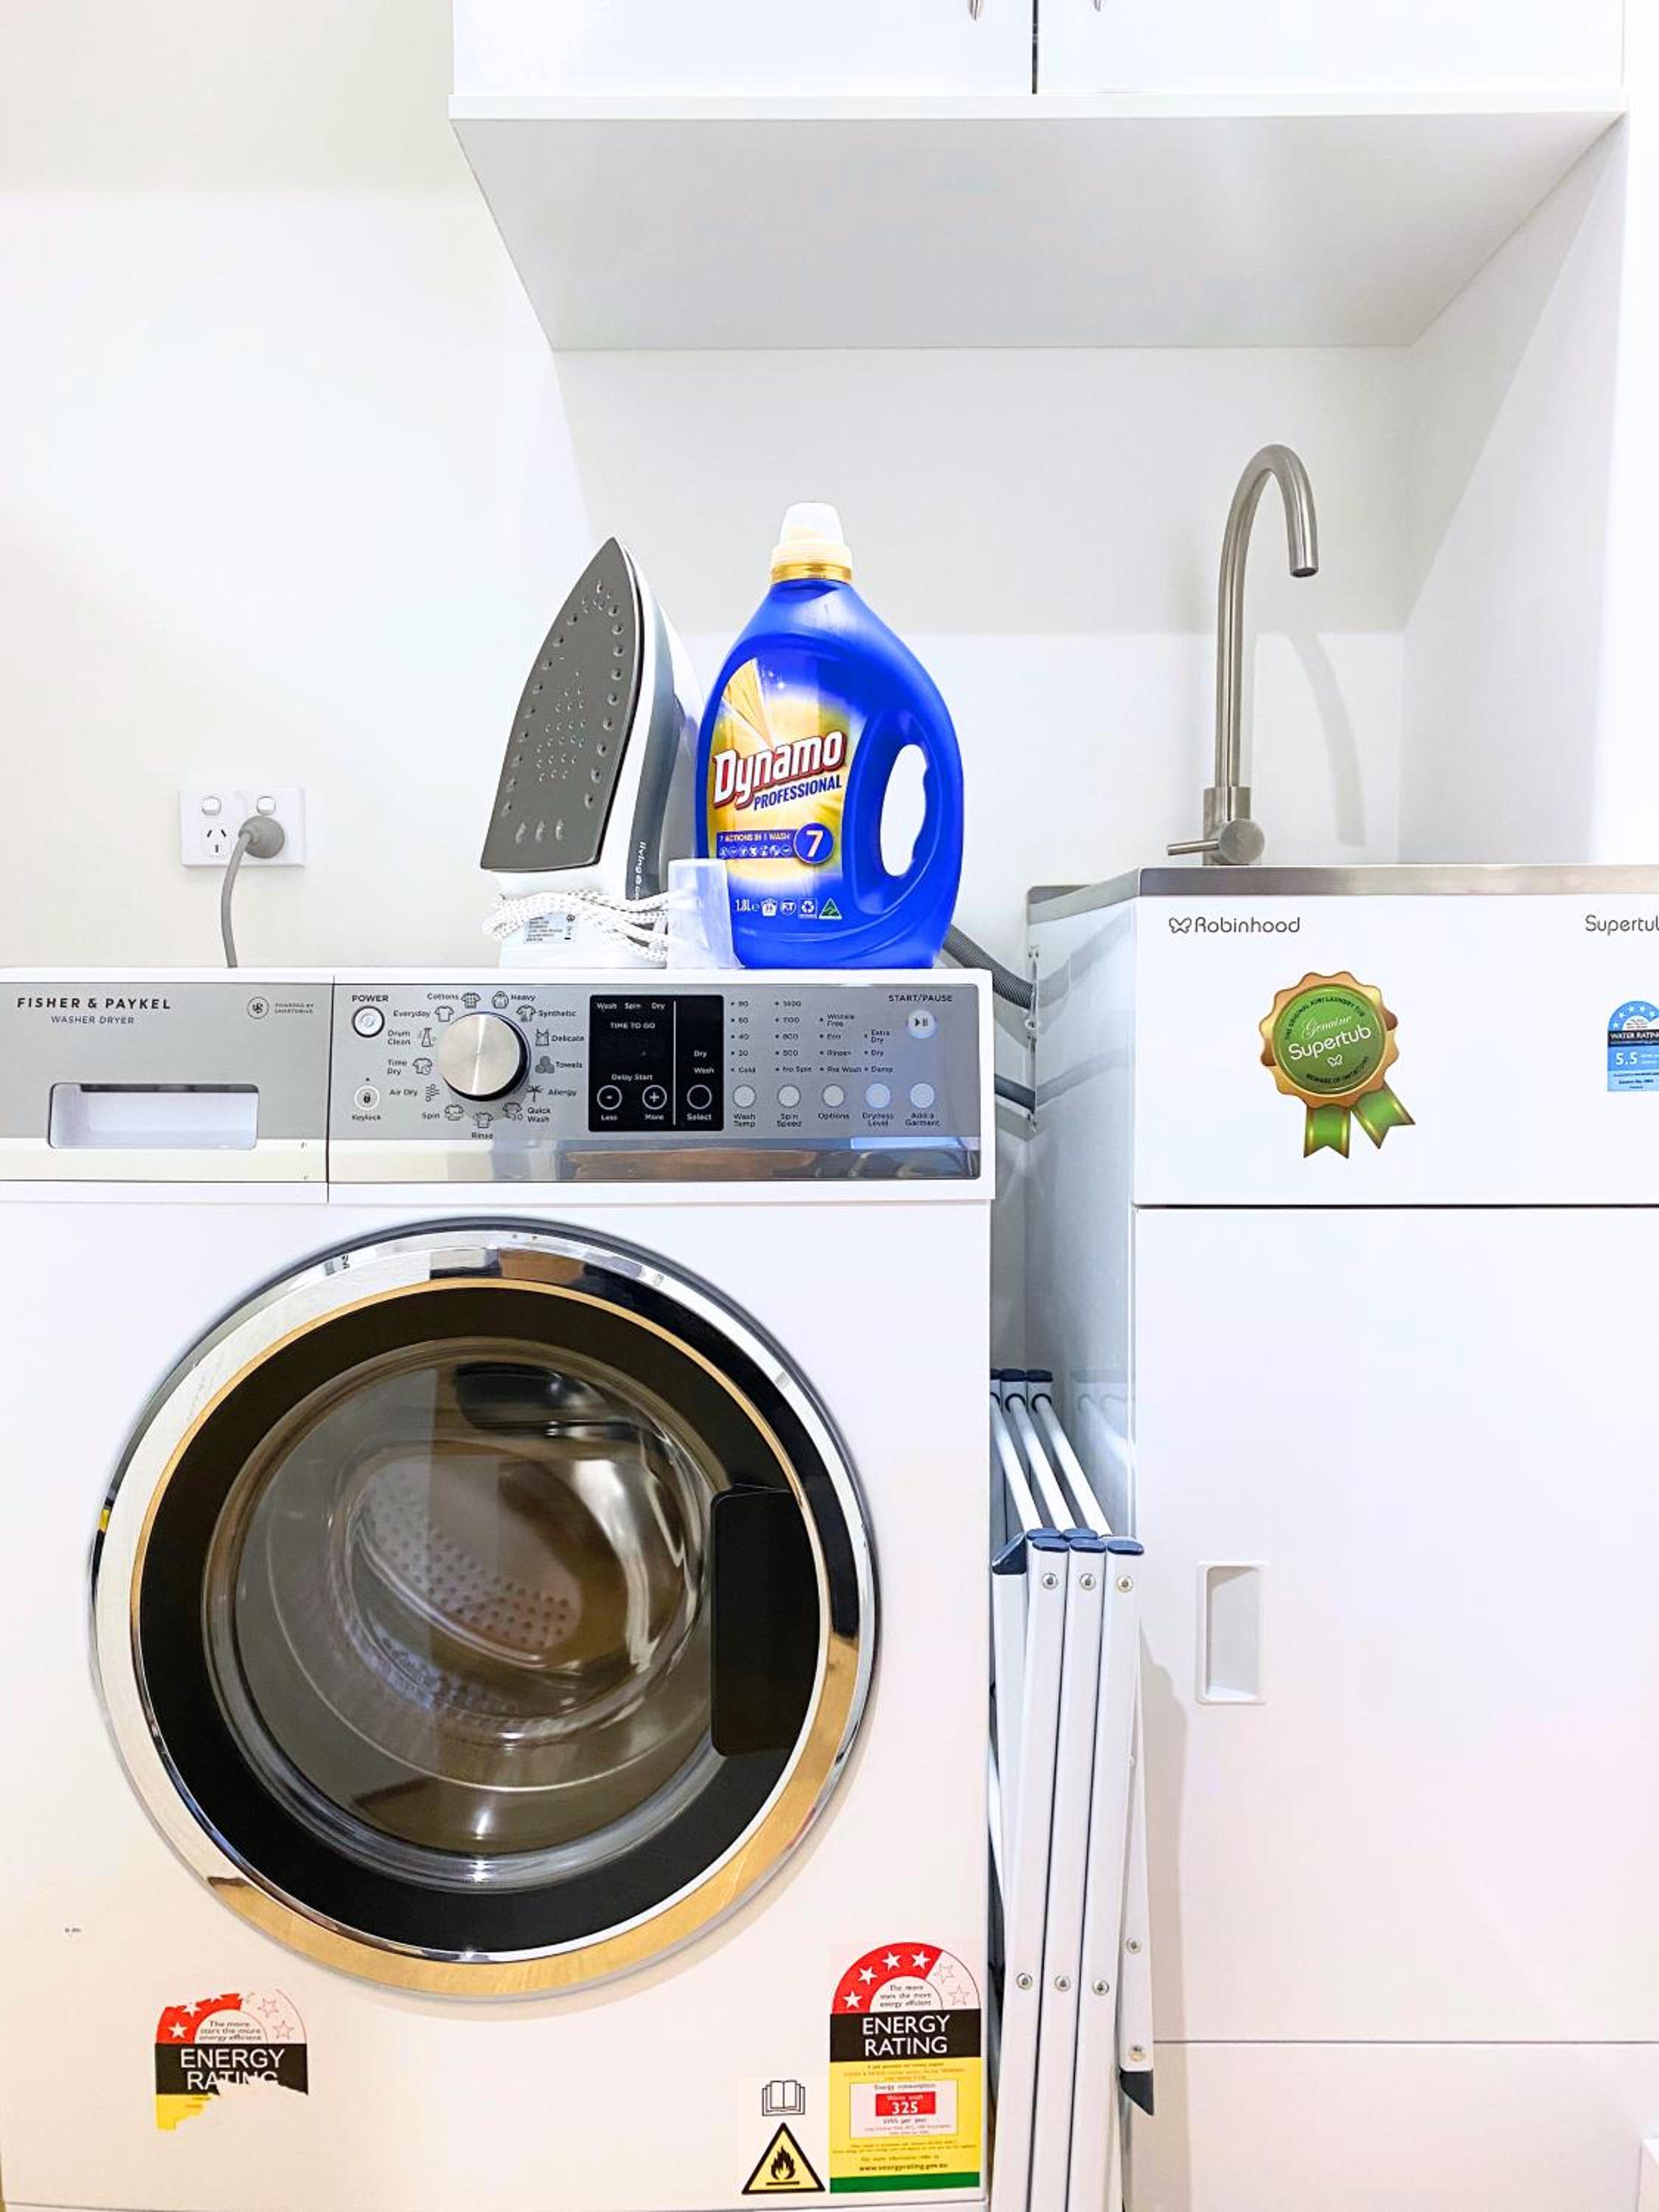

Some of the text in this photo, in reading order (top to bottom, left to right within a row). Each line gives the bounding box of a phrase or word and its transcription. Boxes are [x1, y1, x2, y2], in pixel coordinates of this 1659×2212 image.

[714, 731, 847, 810] Dynamo
[754, 774, 842, 810] PROFESSIONAL
[770, 832, 790, 841] WASH
[806, 830, 824, 858] 7
[1194, 917, 1301, 933] Robinhood
[510, 993, 536, 1001] Heavy
[888, 994, 953, 1002] START/PAUSE
[17, 997, 171, 1010] FISHER & PAYKEL
[625, 1003, 641, 1011] Spin
[652, 1003, 665, 1011] Dry
[538, 1009, 577, 1018] Synthetic
[51, 1015, 134, 1025] WASHER DRYER
[552, 1034, 584, 1042] Delicate
[1289, 1025, 1371, 1060] Supertub
[694, 1050, 707, 1058] Dry
[1615, 1051, 1637, 1065] 5.5
[387, 1068, 401, 1076] Dry
[611, 1074, 633, 1082] Delay
[389, 1088, 417, 1097] Air Dry
[549, 1088, 577, 1097] Allergy
[352, 1113, 381, 1121] Keylock
[422, 1112, 440, 1121] Spin
[818, 1112, 849, 1121] Options
[863, 1112, 894, 1121] Dryness
[734, 1120, 755, 1128] Temp
[776, 1120, 802, 1128] Speed
[905, 1119, 940, 1127] Garment
[472, 1131, 493, 1140] Rinse
[863, 2014, 950, 2035] ENERGY
[865, 2037, 948, 2056] RATING
[181, 2048, 285, 2067] ENERGY
[891, 2101, 919, 2115] 325
